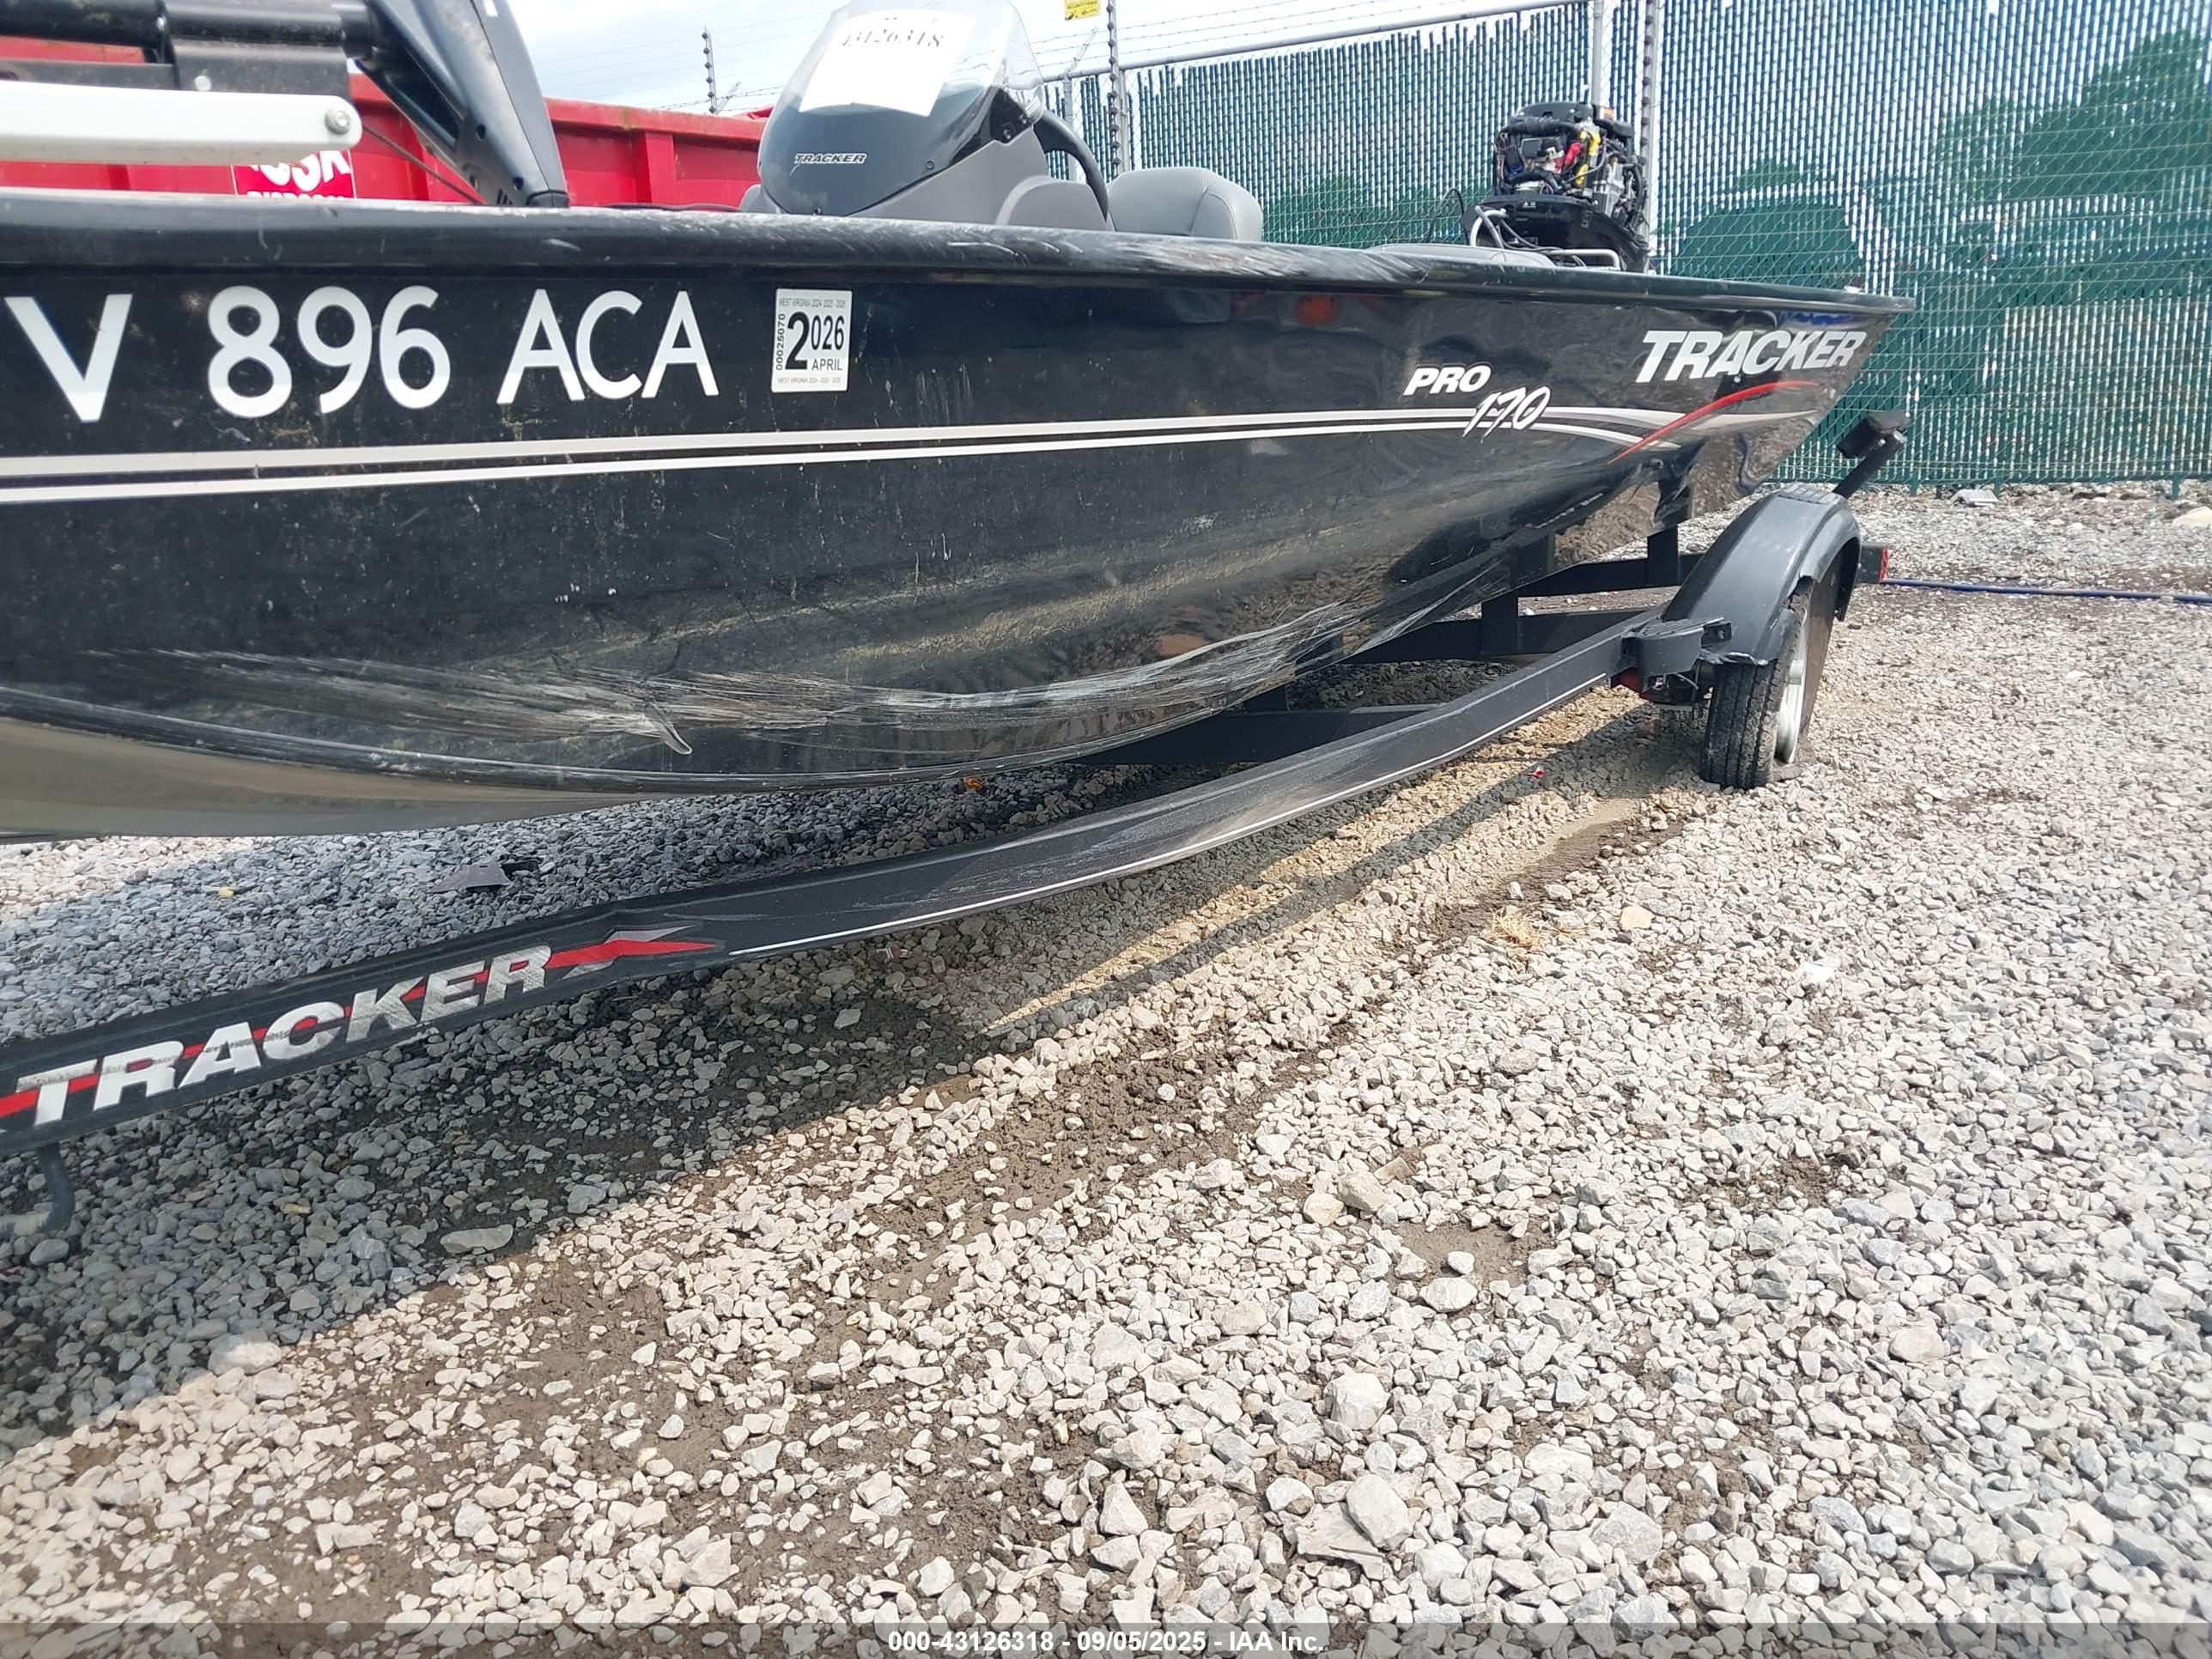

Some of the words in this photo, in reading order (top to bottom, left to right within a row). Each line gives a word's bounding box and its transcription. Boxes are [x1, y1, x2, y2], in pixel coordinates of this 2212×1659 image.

[794, 153, 867, 164] TRACKER
[4, 293, 132, 423] V
[208, 285, 451, 419] 896
[496, 289, 720, 404] ACA
[776, 313, 787, 371] 00025070
[811, 359, 843, 371] APRIL
[1636, 331, 1866, 384] TRACKER
[1403, 365, 1492, 396] PRO
[1462, 386, 1552, 439] 170
[17, 945, 552, 1127] TRACKER
